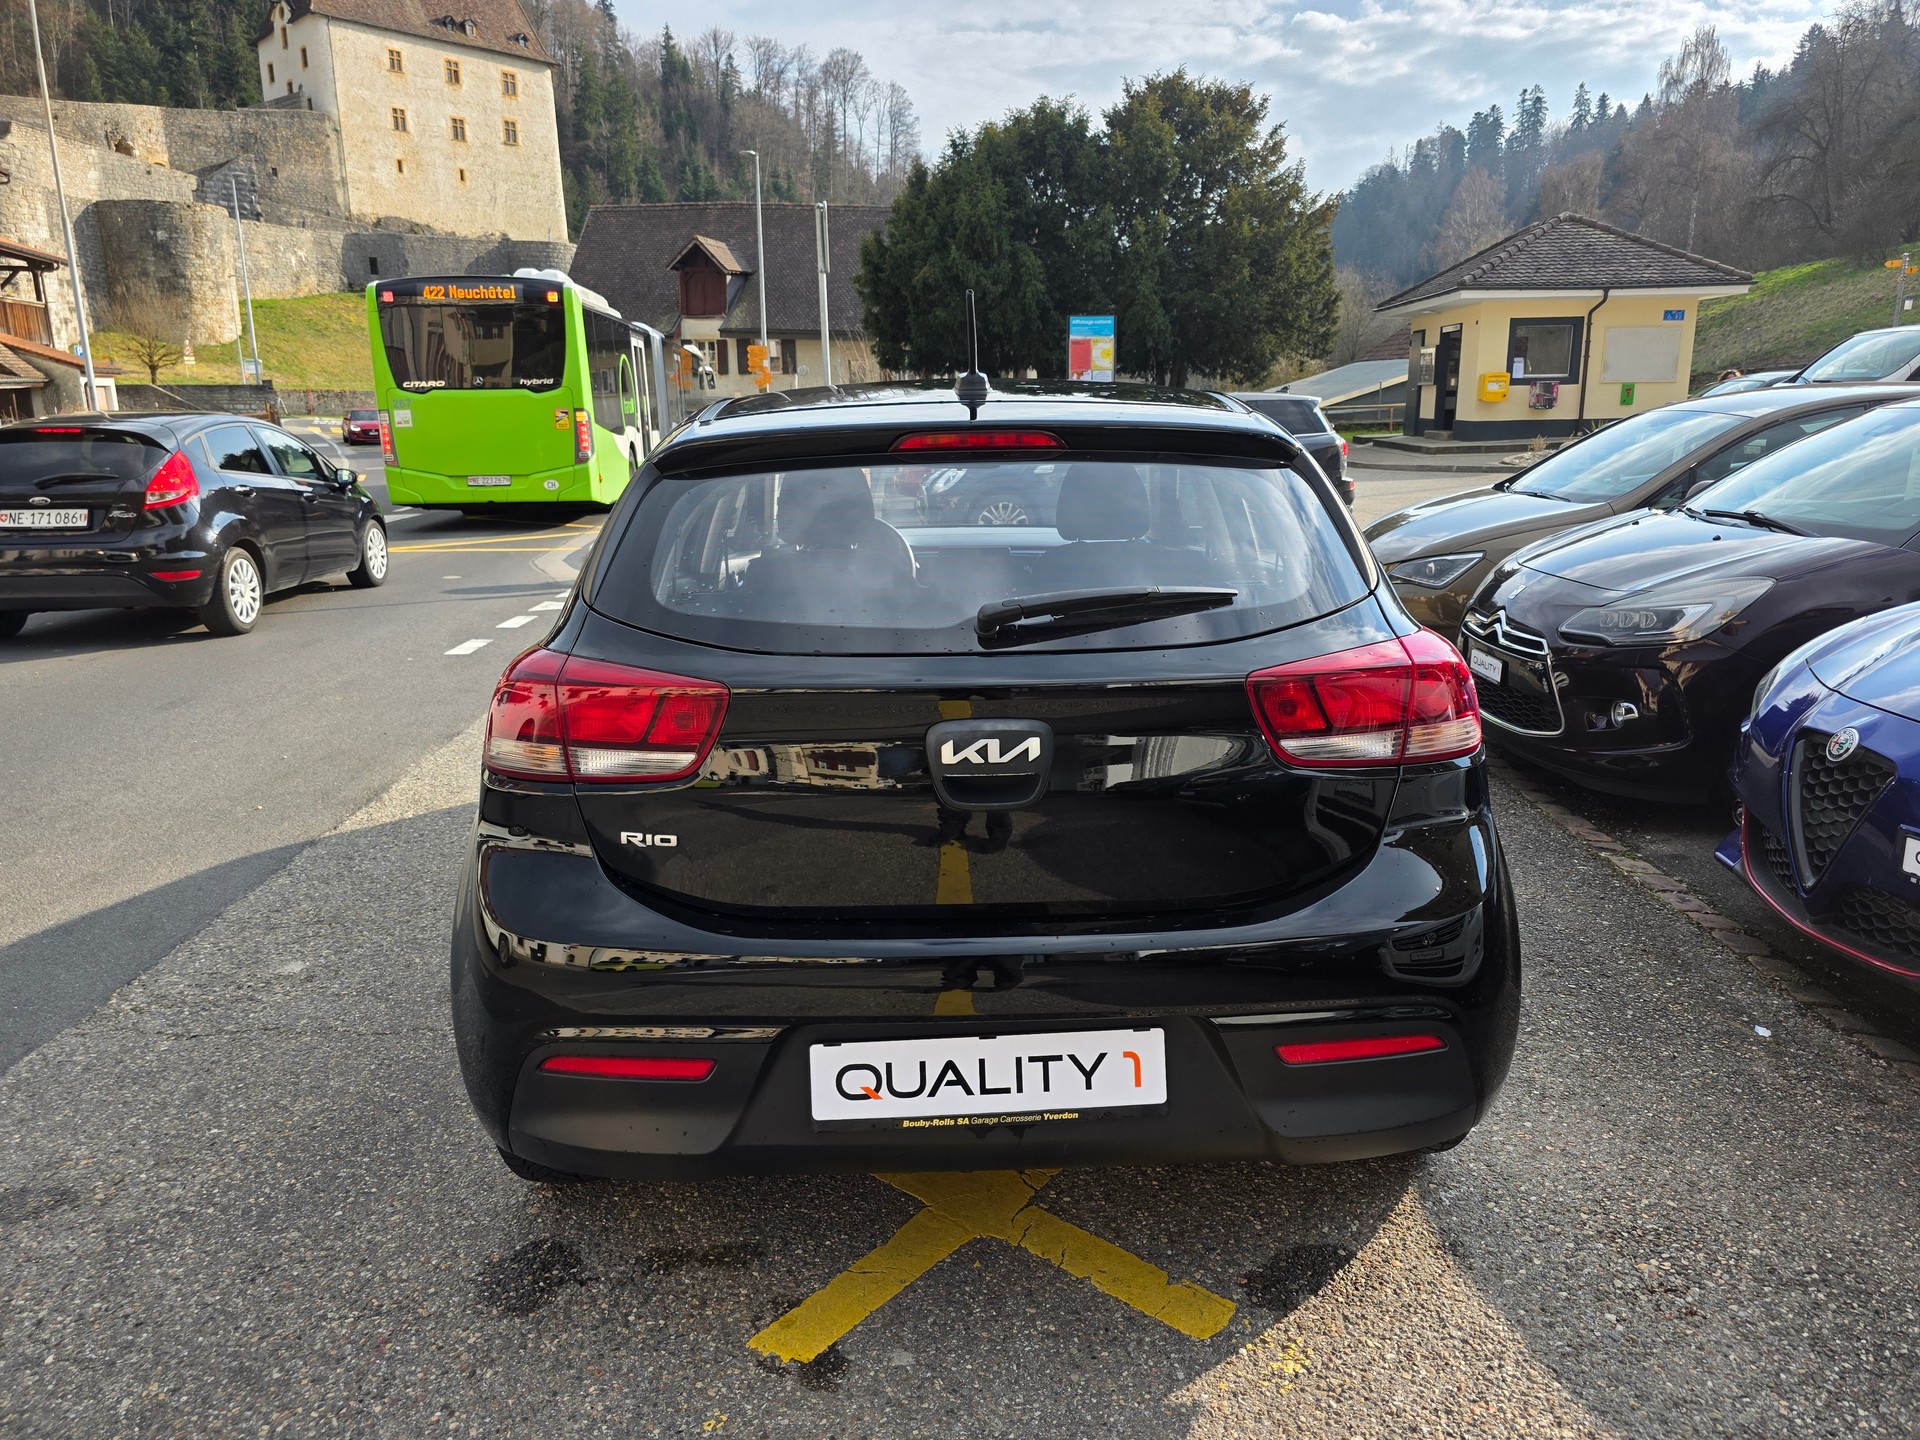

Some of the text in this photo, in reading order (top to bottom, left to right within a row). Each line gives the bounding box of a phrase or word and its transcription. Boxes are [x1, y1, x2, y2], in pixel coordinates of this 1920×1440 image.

[423, 285, 517, 299] 422 Neuchâtel
[402, 380, 446, 388] CITARO
[393, 399, 412, 408] 267
[546, 481, 557, 489] CH
[1472, 655, 1497, 674] QUALITY
[940, 736, 1040, 764] KIA
[620, 831, 678, 847] RIO
[835, 1050, 1142, 1101] QUALITY 1
[902, 1112, 1079, 1128] Bouby-Rolls SA Garage Carrosserie Yverdon
